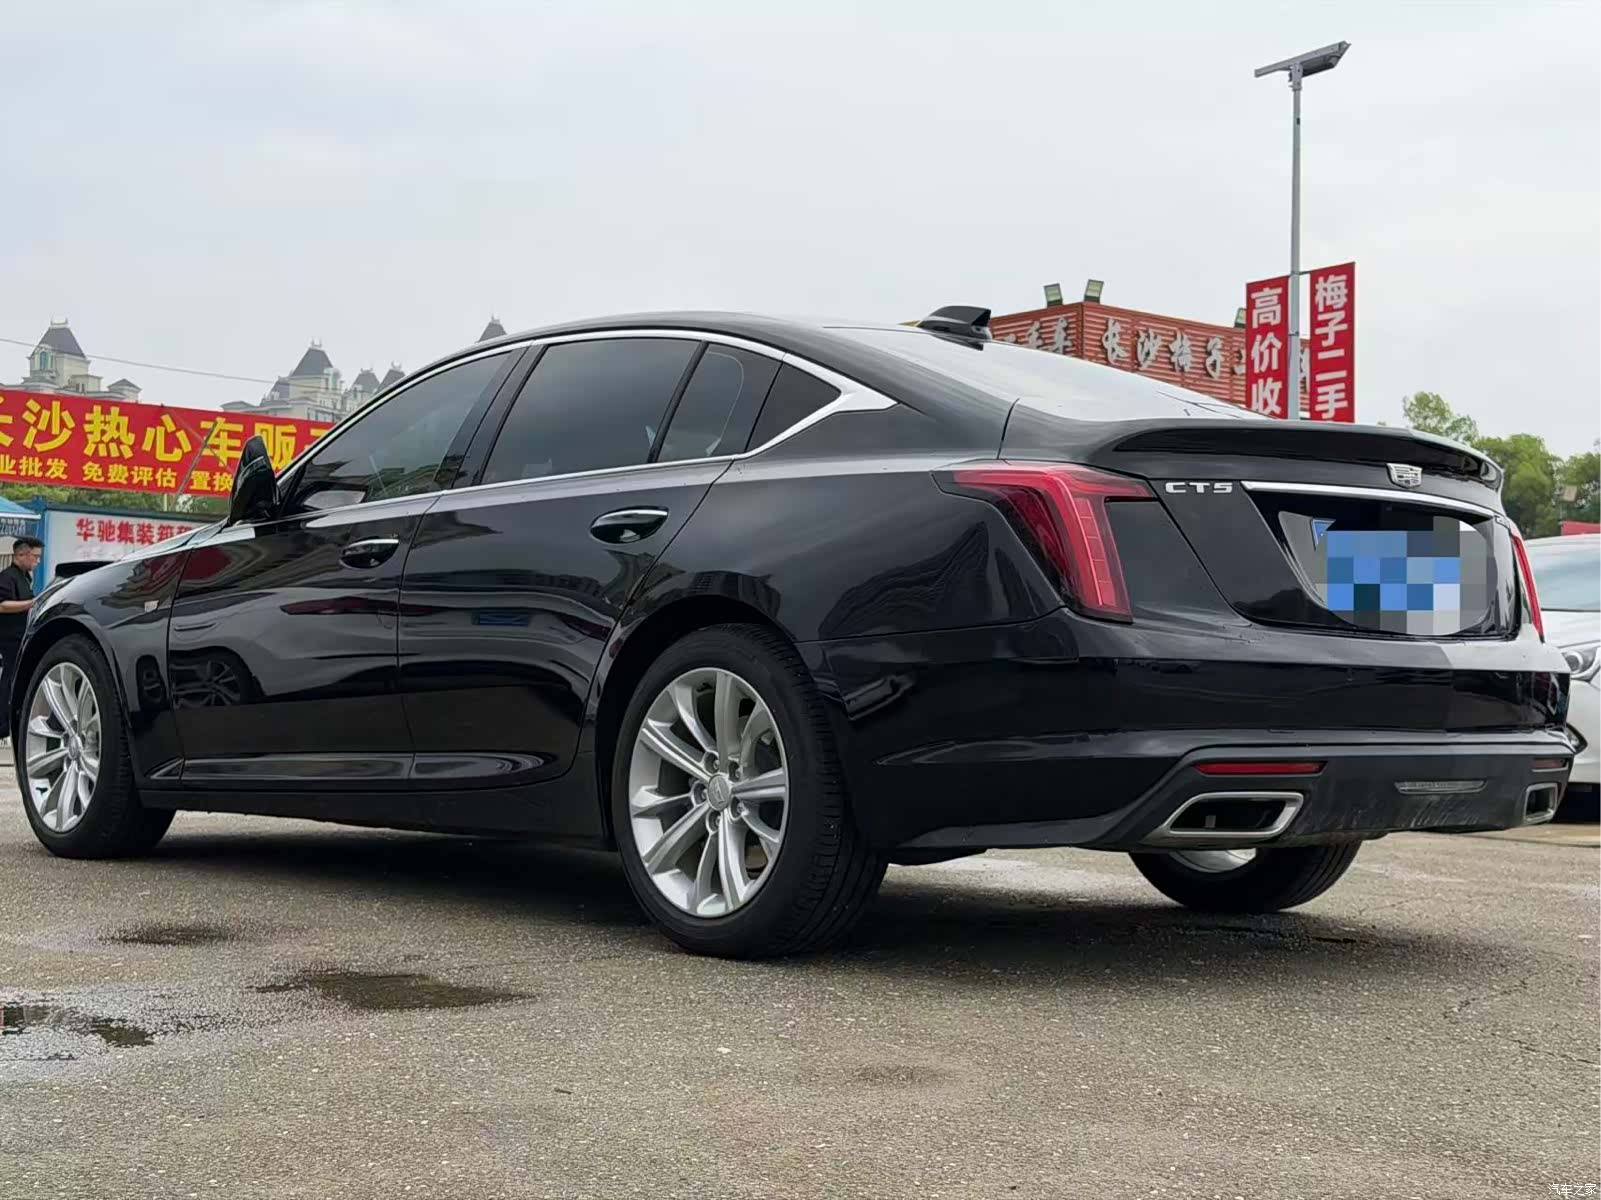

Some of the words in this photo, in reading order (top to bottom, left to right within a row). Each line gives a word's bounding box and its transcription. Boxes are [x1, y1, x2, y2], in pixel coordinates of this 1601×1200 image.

[1250, 286, 1283, 416] 高价收
[0, 396, 328, 469] 沙热心车贩
[82, 460, 177, 489] 免费评估
